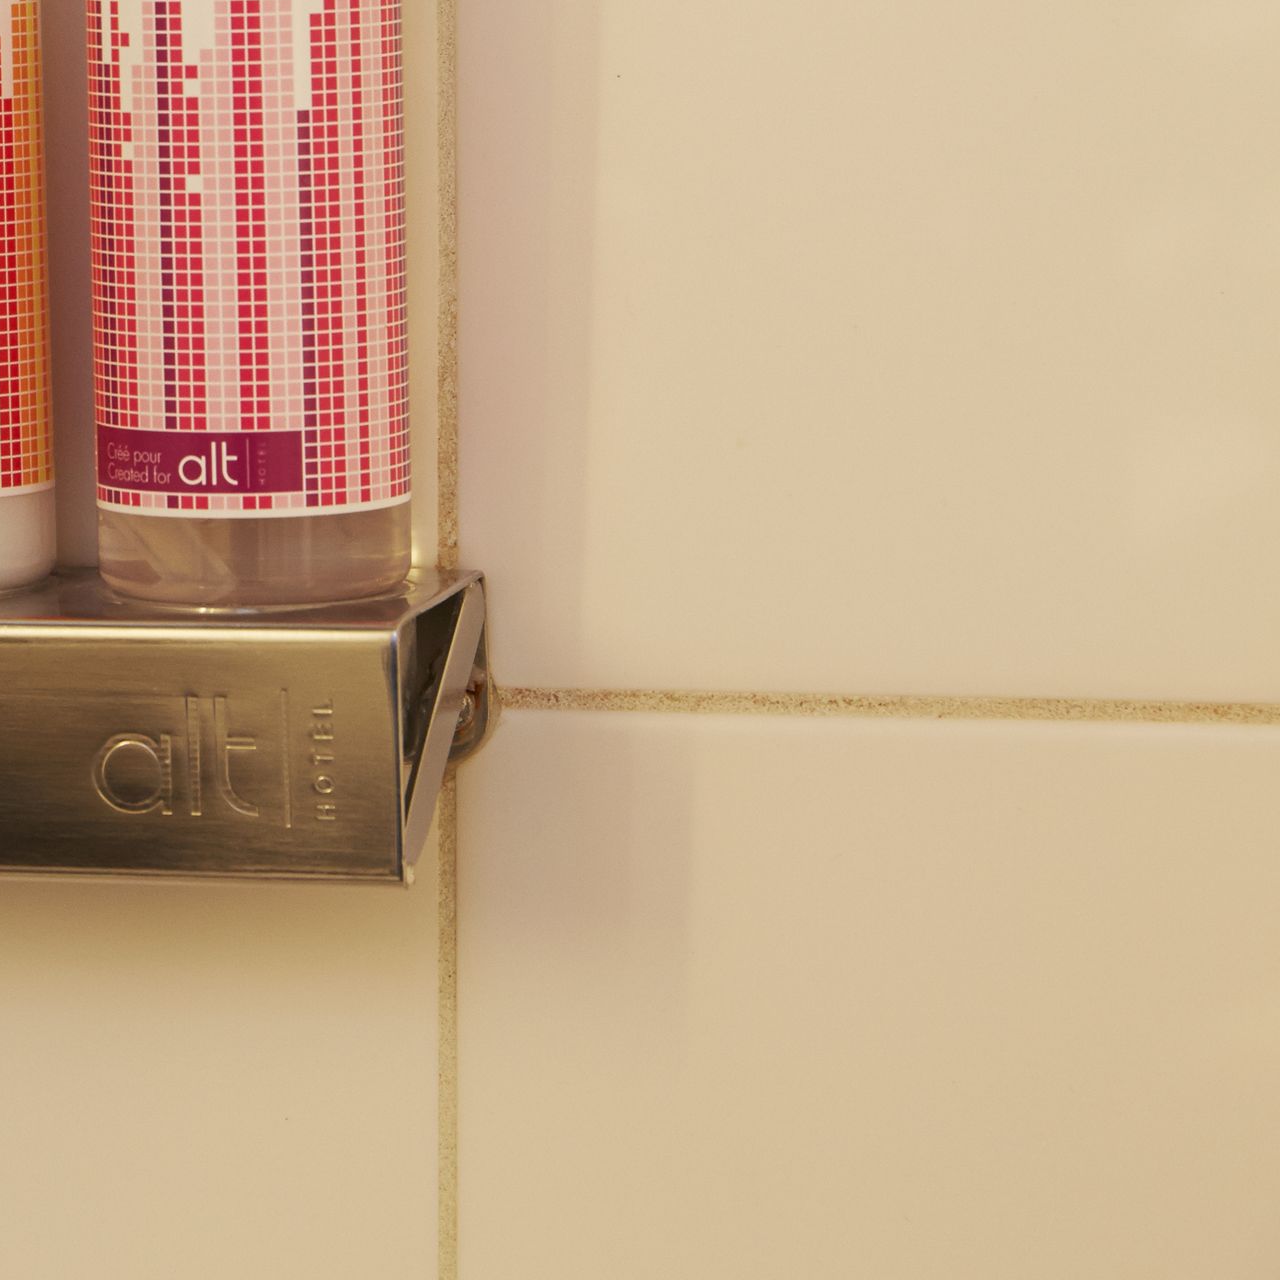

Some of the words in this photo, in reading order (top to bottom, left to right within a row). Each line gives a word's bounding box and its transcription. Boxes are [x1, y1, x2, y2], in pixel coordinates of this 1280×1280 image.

[107, 462, 149, 482] Created
[154, 465, 171, 483] for
[134, 450, 161, 464] pour
[178, 441, 238, 486] alt
[91, 695, 259, 816] alt
[312, 698, 336, 820] HOTEL
